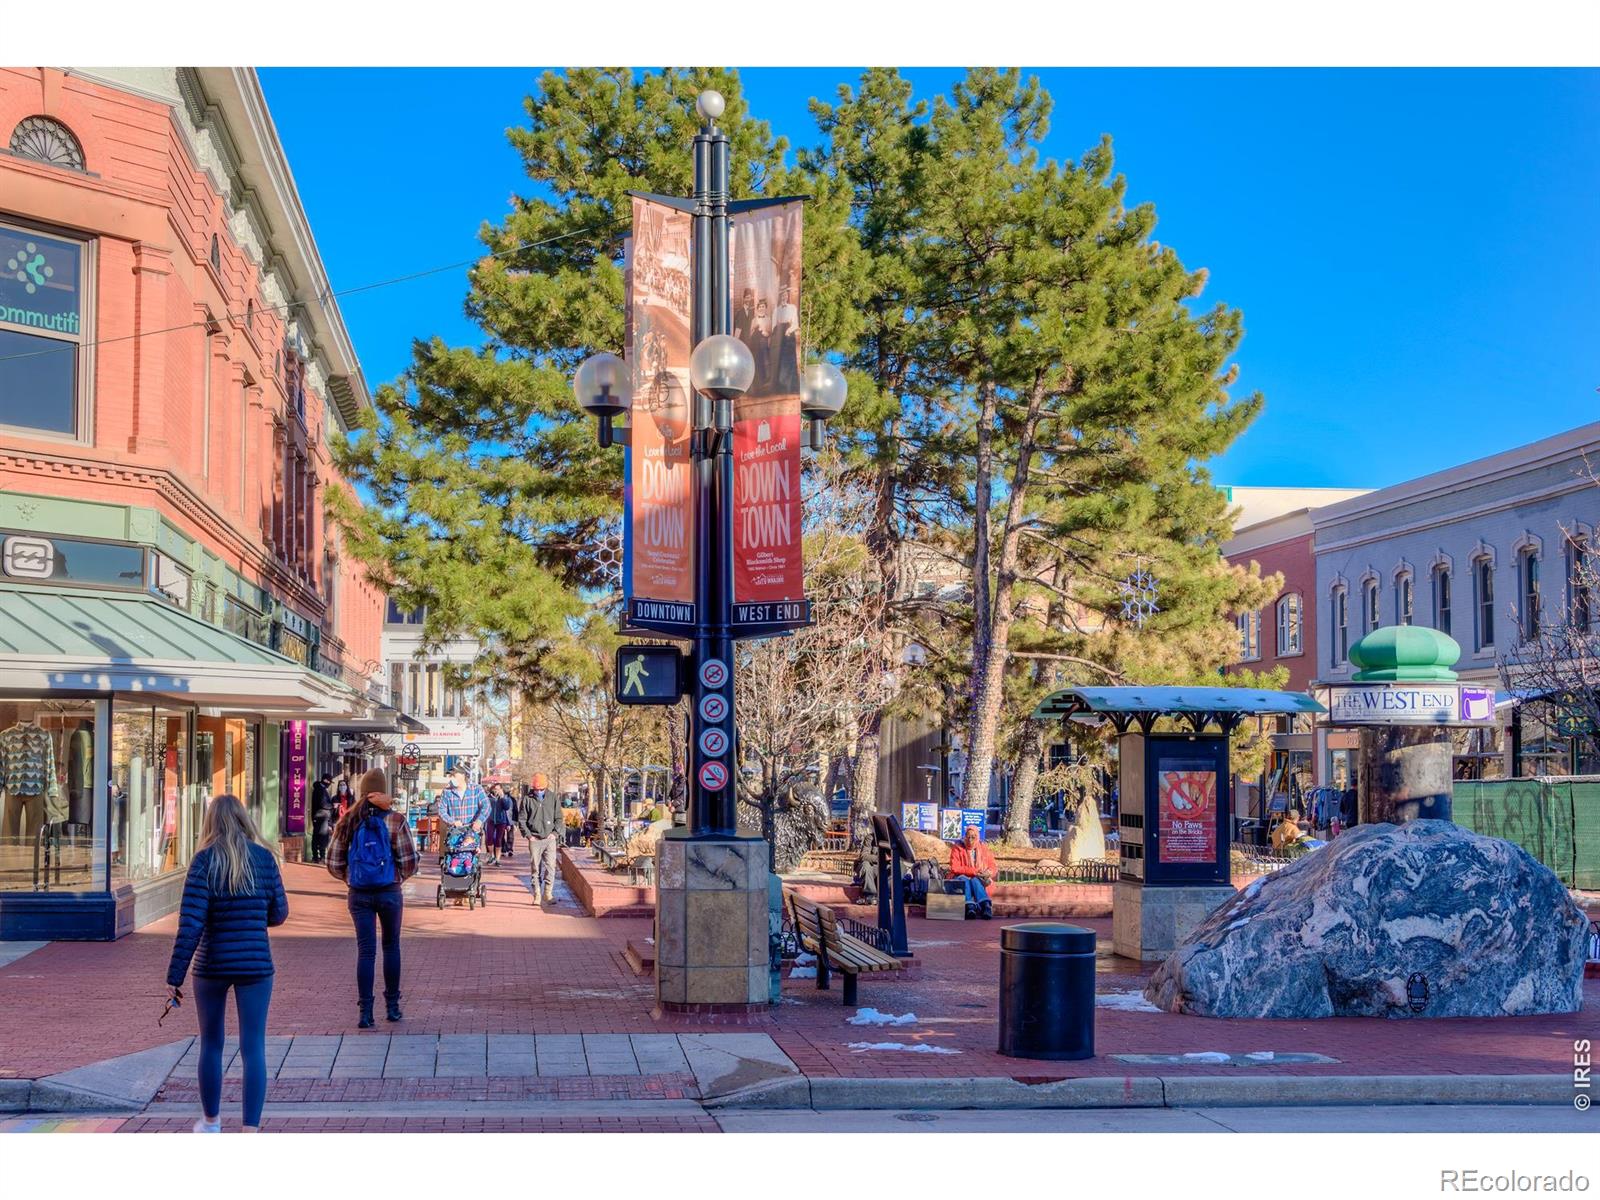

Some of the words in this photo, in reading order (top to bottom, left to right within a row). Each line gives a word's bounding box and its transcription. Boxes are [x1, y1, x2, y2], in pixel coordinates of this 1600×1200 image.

[740, 449, 755, 463] Love
[755, 443, 766, 457] the
[766, 438, 787, 455] Local
[642, 459, 684, 503] DOWN
[740, 459, 790, 505] DOWN
[641, 504, 685, 549] TOWN
[741, 503, 791, 549] TOWN
[637, 602, 691, 622] DOWNTOWN
[739, 605, 771, 622] WEST
[776, 604, 800, 620] END
[1335, 695, 1361, 709] THE
[1363, 691, 1420, 710] WEST
[1422, 694, 1454, 708] END
[293, 768, 302, 785] THE
[293, 786, 302, 809] YEAR
[1172, 820, 1183, 829] No
[1184, 820, 1203, 829] Paws
